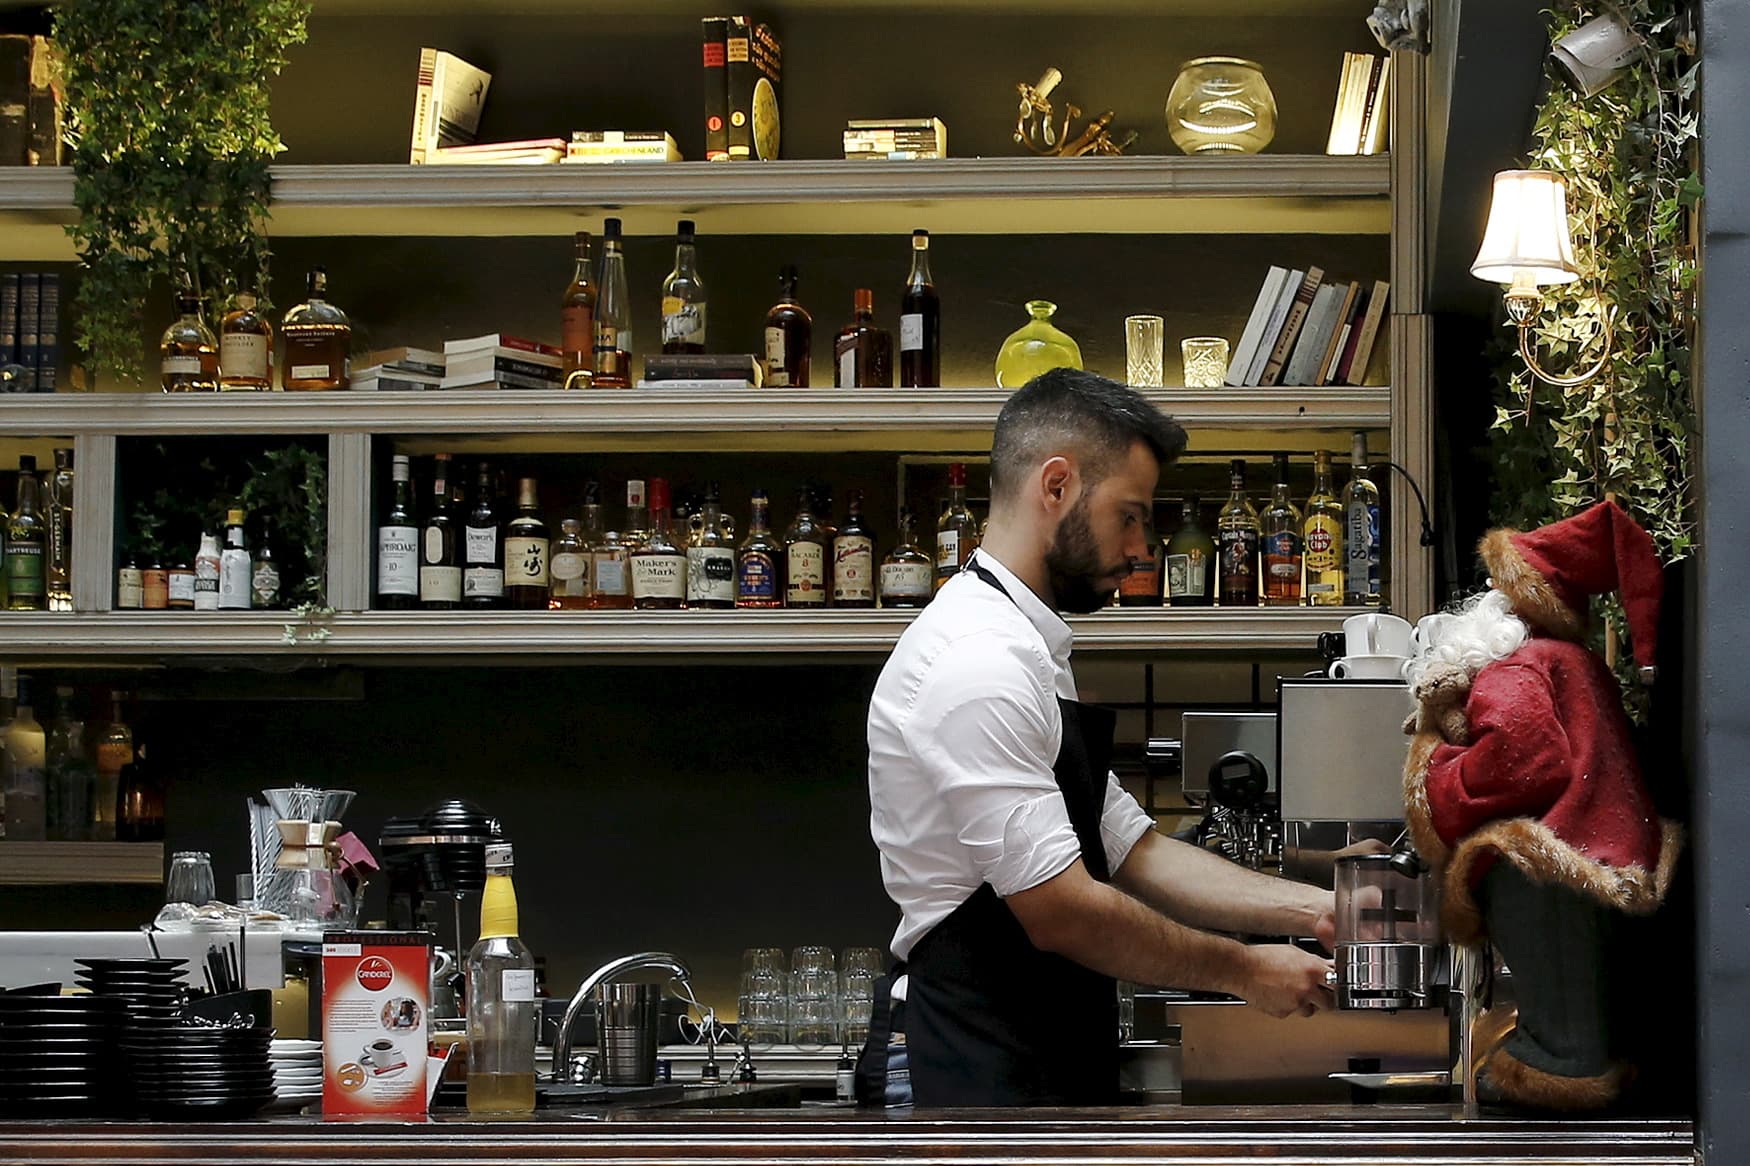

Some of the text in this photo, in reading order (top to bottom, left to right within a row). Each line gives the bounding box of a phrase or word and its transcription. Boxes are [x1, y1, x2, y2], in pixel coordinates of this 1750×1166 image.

[1351, 507, 1367, 560] Sagatiba
[637, 559, 677, 567] Maker's
[647, 568, 676, 576] Mark
